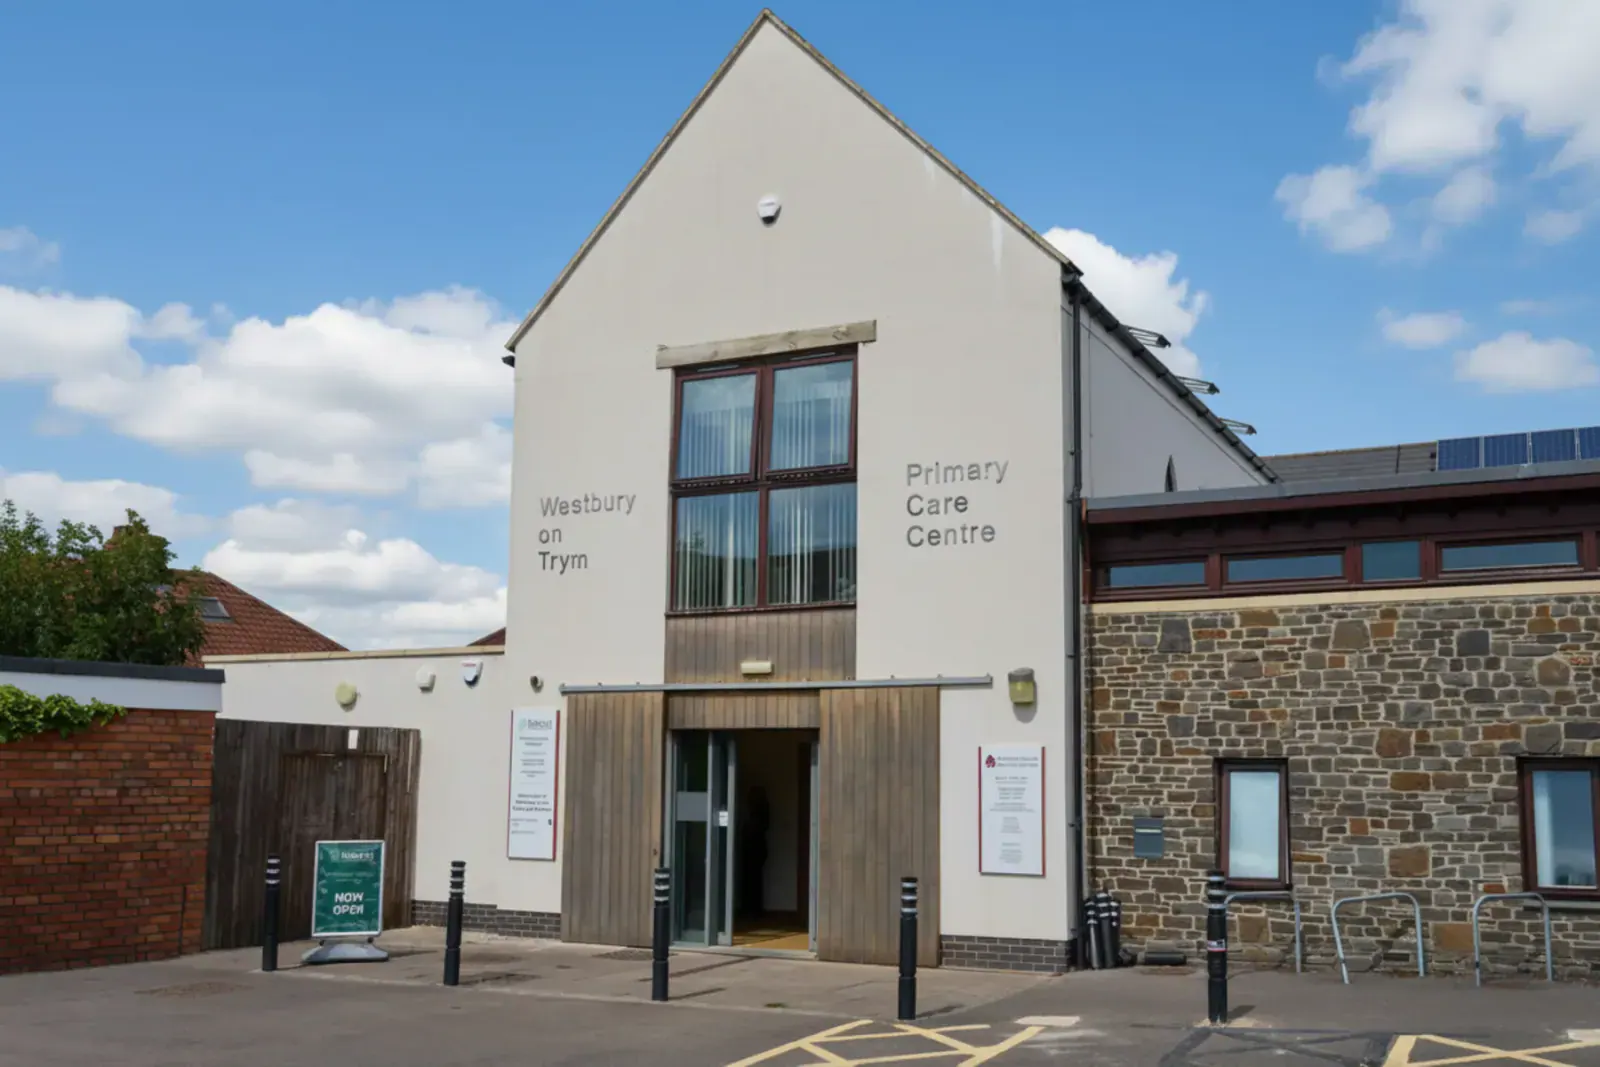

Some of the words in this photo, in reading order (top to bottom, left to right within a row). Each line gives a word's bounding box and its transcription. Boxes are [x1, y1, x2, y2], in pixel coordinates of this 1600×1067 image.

[907, 461, 1009, 486] Primary
[540, 493, 636, 517] Westbury
[907, 494, 968, 516] Care
[538, 528, 562, 544] on
[907, 524, 996, 547] Centre
[538, 551, 588, 575] Trym
[335, 892, 364, 903] NOW
[333, 904, 364, 915] OPEN
